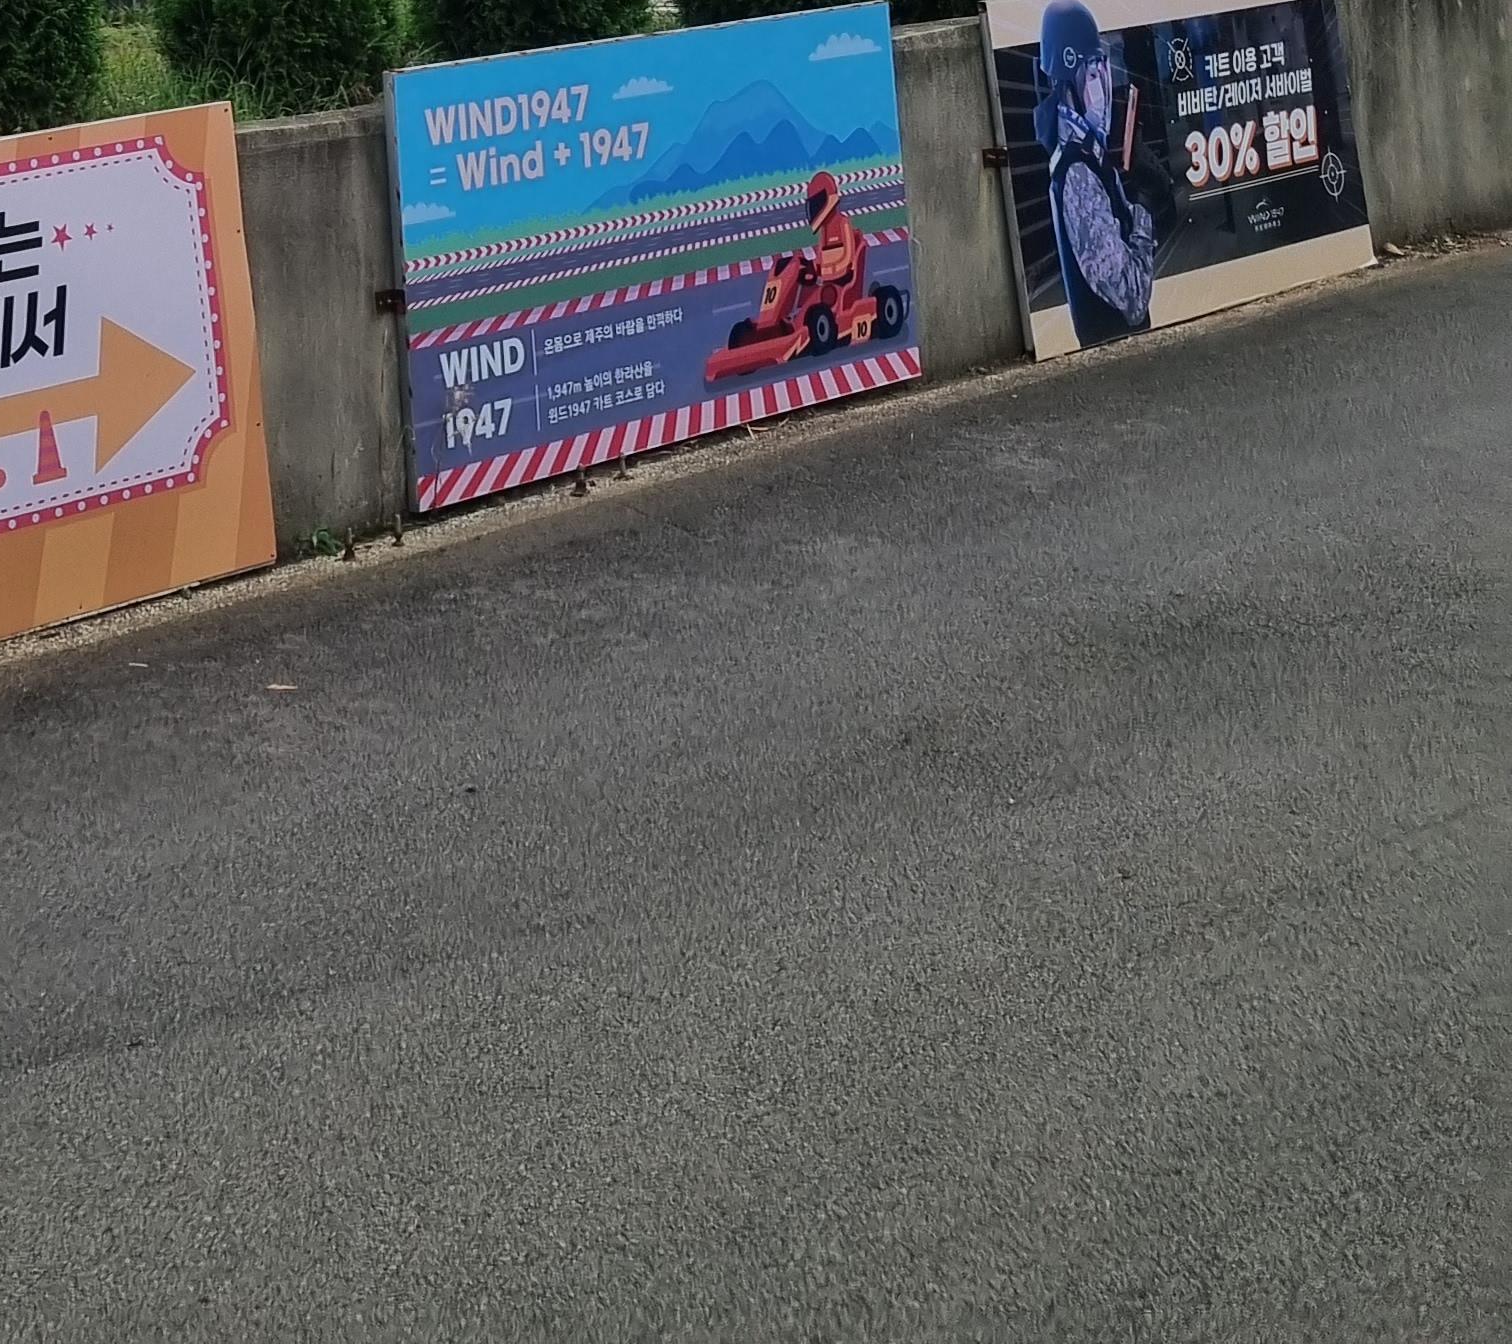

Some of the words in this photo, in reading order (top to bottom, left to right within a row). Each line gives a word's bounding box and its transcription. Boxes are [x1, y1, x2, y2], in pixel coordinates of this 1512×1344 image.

[1205, 52, 1231, 78] 카트
[1232, 47, 1257, 74] 이용
[1260, 42, 1285, 70] 고객
[424, 84, 589, 146] WIND1947
[1178, 77, 1262, 117] 비비탄/레이저
[1265, 68, 1313, 99] 서바이벌
[456, 140, 544, 191] Wind
[579, 122, 649, 169] 1947
[1185, 120, 1260, 187] 30%
[1263, 105, 1319, 170] 할인
[764, 286, 777, 305] 10
[544, 332, 583, 355] 온몸으로
[585, 323, 614, 344] 제주의
[615, 317, 645, 337] 바람을
[857, 321, 867, 338] 10
[439, 337, 525, 388] WIND
[547, 380, 583, 402] 1,947m
[584, 371, 613, 392] 높이의
[614, 360, 653, 385] 한라산을
[442, 398, 512, 449] 1947
[548, 400, 591, 424] 윈드1947
[593, 394, 614, 411] 카트
[615, 386, 644, 406] 코스로
[646, 379, 665, 400] 담다
